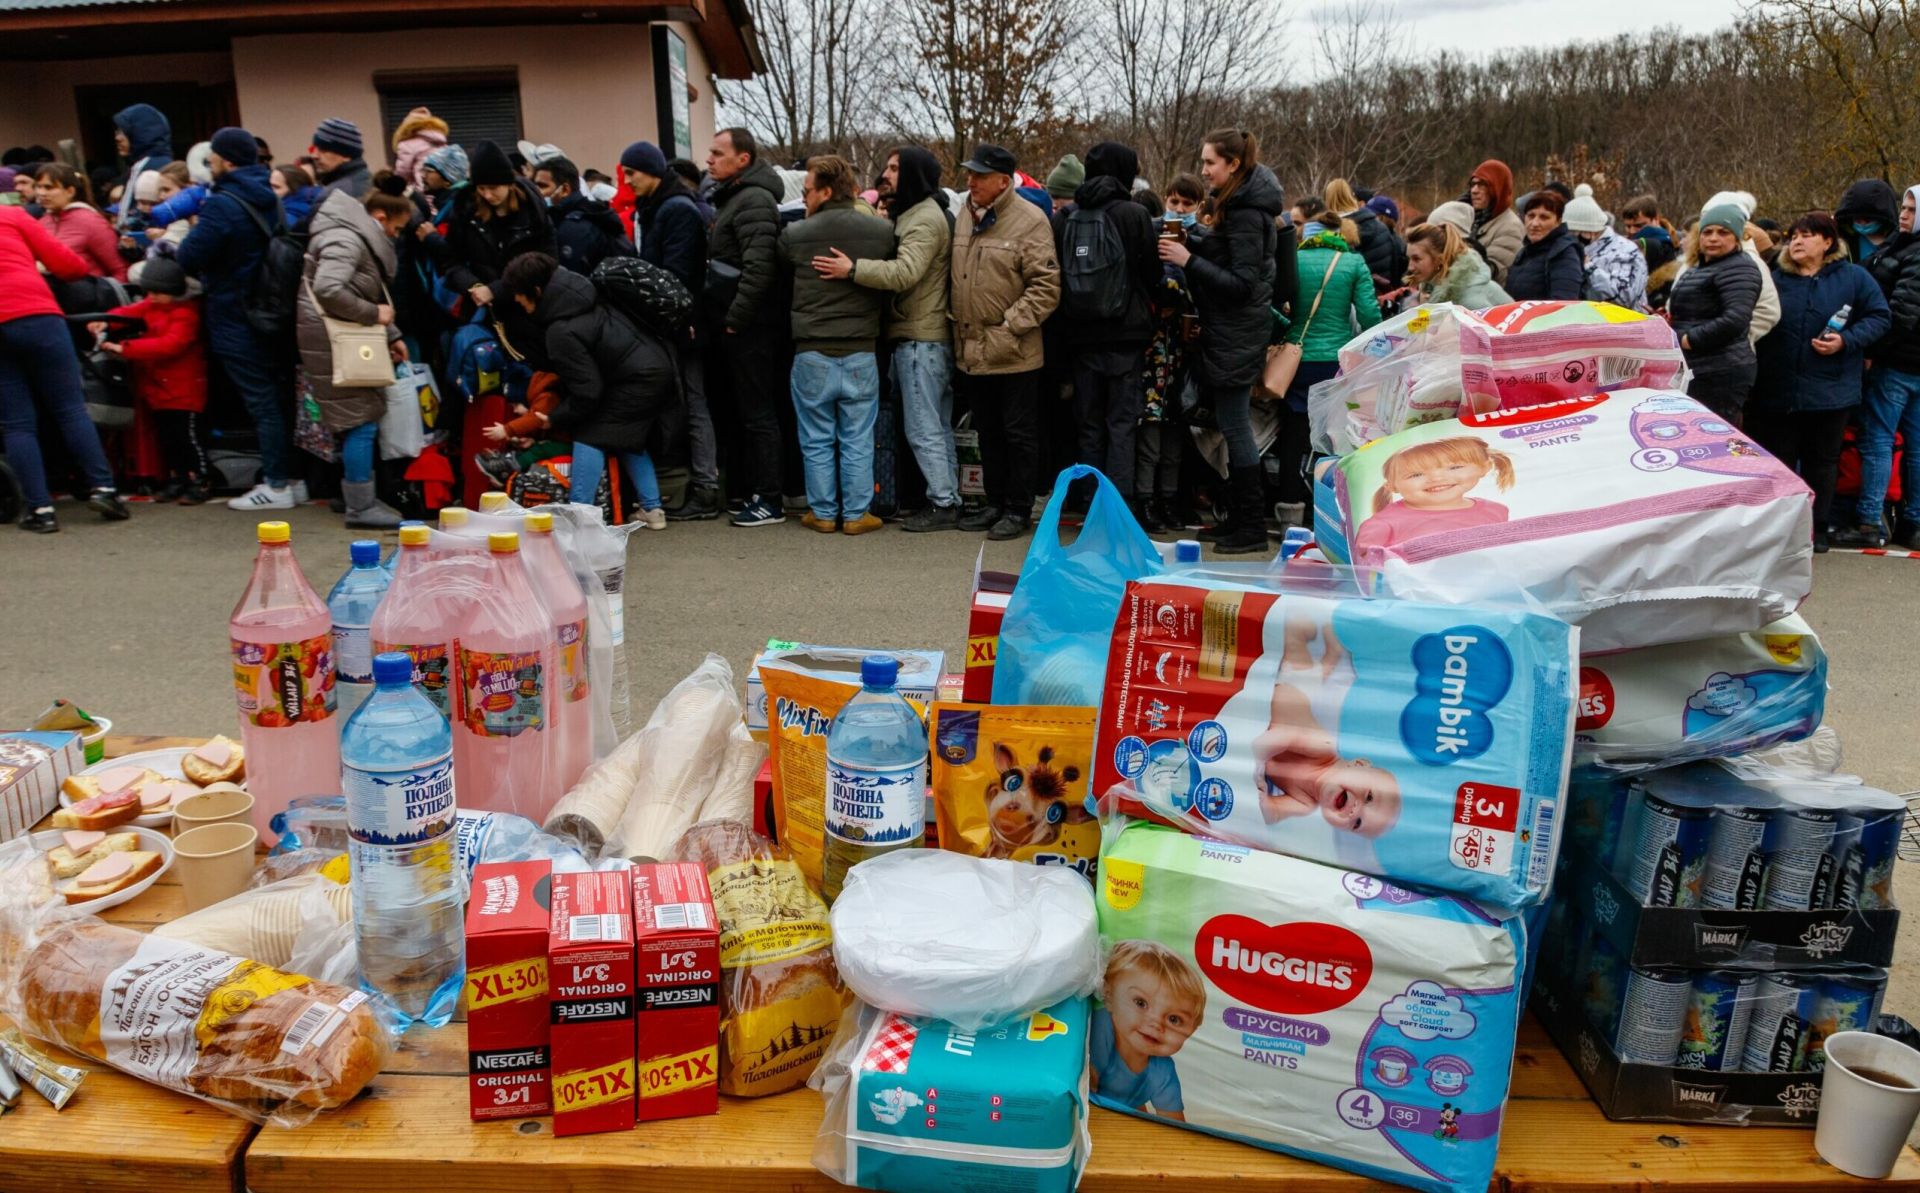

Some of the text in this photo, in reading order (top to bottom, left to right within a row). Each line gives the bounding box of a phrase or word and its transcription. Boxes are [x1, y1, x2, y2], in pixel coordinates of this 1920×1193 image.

[1511, 416, 1588, 435] ТРУСИКИ
[1529, 433, 1581, 449] PANTS
[1643, 450, 1666, 464] 6
[1686, 448, 1704, 456] 30
[1434, 635, 1479, 754] bambik
[776, 697, 831, 737] MixFix
[404, 776, 452, 804] ПОЛЯНА
[832, 781, 885, 804] ПОЛЯНА
[405, 790, 453, 820] КУПЕЛЬ
[832, 798, 884, 820] КУПЕЛЬ
[1461, 787, 1475, 824] розмір
[1475, 798, 1504, 818] 3
[1200, 849, 1243, 864] PANTS
[1462, 837, 1479, 863] 45
[761, 940, 776, 950] 550
[1702, 930, 1739, 946] MÁRKA
[1211, 936, 1352, 990] HUGGIES
[646, 970, 712, 984] ORIGINAL
[558, 982, 626, 997] ORIGINAL
[1410, 989, 1448, 1002] Мягкие,
[1405, 1003, 1451, 1017] облачко
[1420, 999, 1437, 1007] как
[1235, 1012, 1319, 1041] ТРУСИКИ
[1399, 1019, 1454, 1033] SOFT COMFORT
[1411, 1013, 1444, 1026] Cloud
[138, 1012, 161, 1065] БАТОН
[1245, 1036, 1303, 1052] МАЛЬЧИКАМ
[1244, 1048, 1298, 1070] PANTS
[477, 1073, 544, 1088] ORIGINAL
[928, 1089, 937, 1098] A
[993, 1097, 1001, 1105] D
[1679, 1087, 1716, 1103] MÁRKA
[1777, 1085, 1822, 1102] JUIC
[928, 1105, 936, 1113] B
[1350, 1094, 1374, 1118] 4
[992, 1112, 999, 1120] E
[1395, 1109, 1413, 1121] 36
[927, 1119, 935, 1128] C
